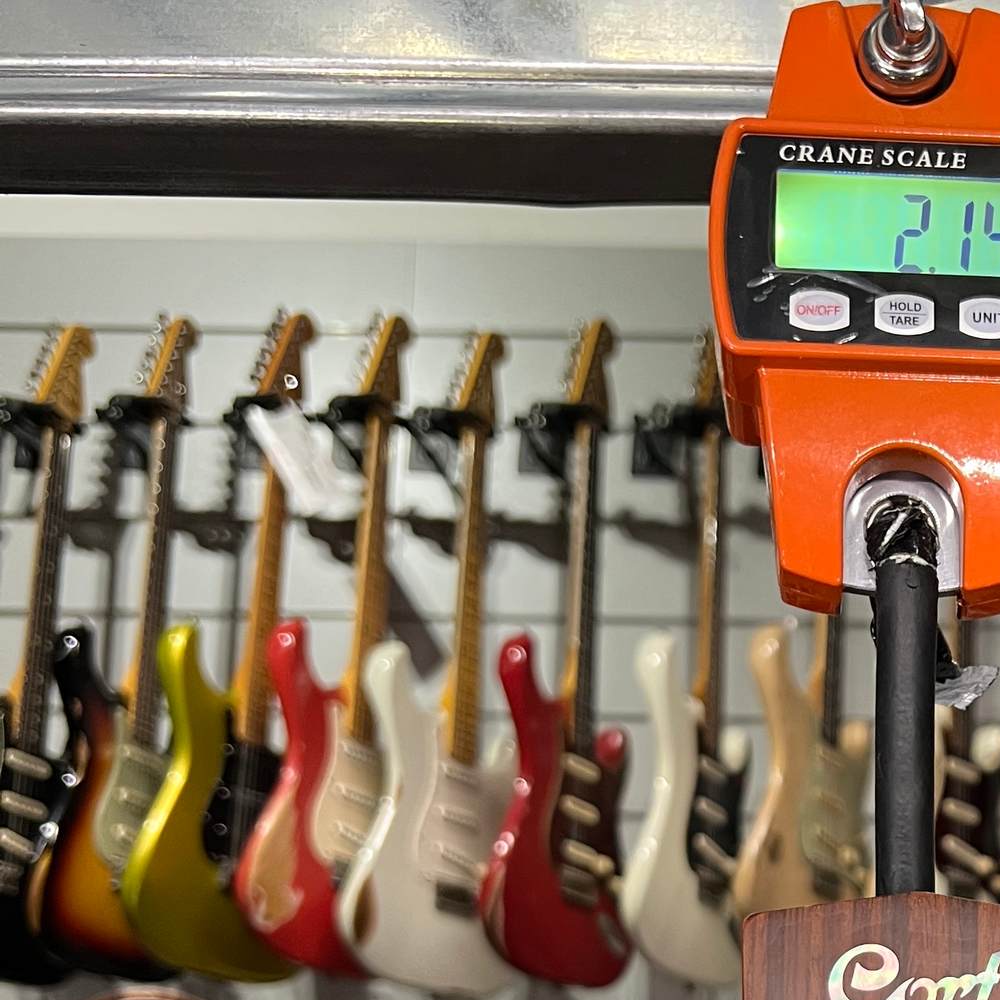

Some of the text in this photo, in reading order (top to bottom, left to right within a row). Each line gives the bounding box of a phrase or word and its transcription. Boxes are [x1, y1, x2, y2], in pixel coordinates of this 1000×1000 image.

[779, 144, 967, 169] CRANE SCALE
[796, 304, 841, 317] ON/OFF
[889, 301, 922, 313] HOLD
[889, 315, 920, 327] TARE
